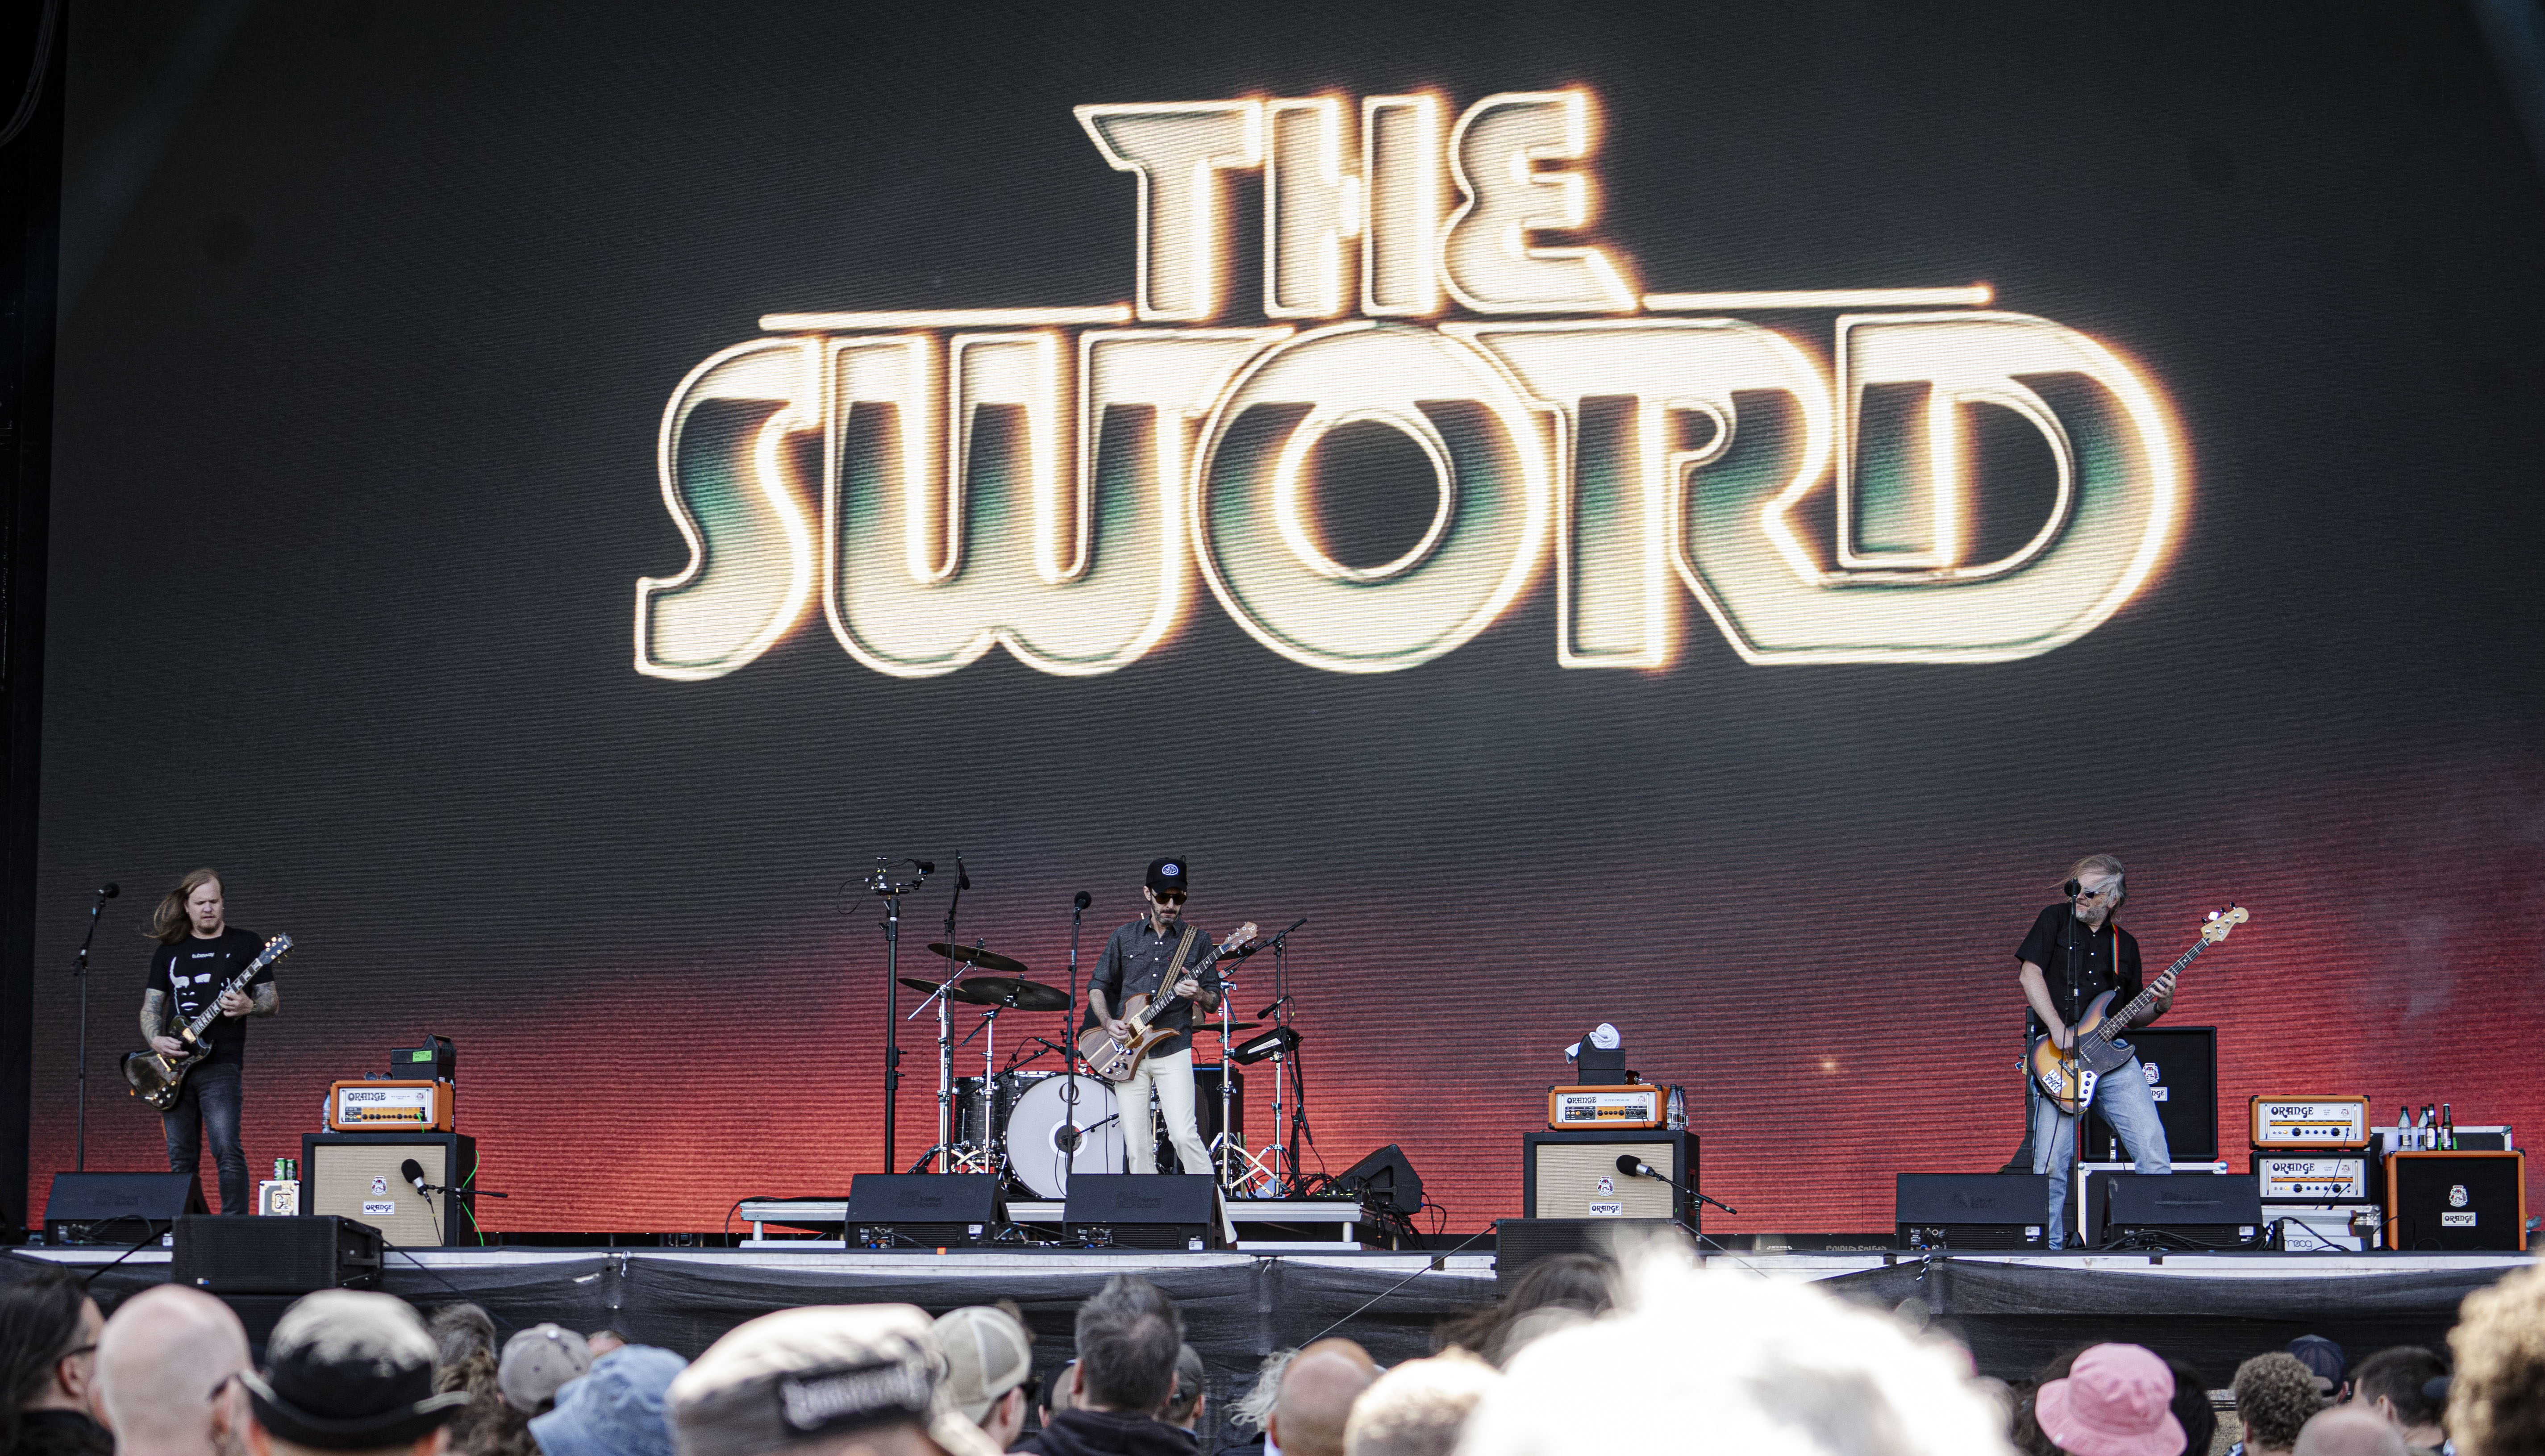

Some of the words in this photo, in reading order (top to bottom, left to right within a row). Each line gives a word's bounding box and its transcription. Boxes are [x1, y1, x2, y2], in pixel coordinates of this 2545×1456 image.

[1074, 88, 1641, 321] THE
[634, 312, 2192, 679] SWORD
[1164, 866, 1176, 874] STP
[348, 1092, 386, 1101] ORANGE
[1059, 1082, 1081, 1106] Q
[2271, 1107, 2314, 1119] ORANGE
[2273, 1163, 2315, 1174] ORANGE
[1591, 1205, 1619, 1213] ORANGE
[2445, 1215, 2473, 1223] ORANGE
[2284, 1240, 2312, 1250] moog
